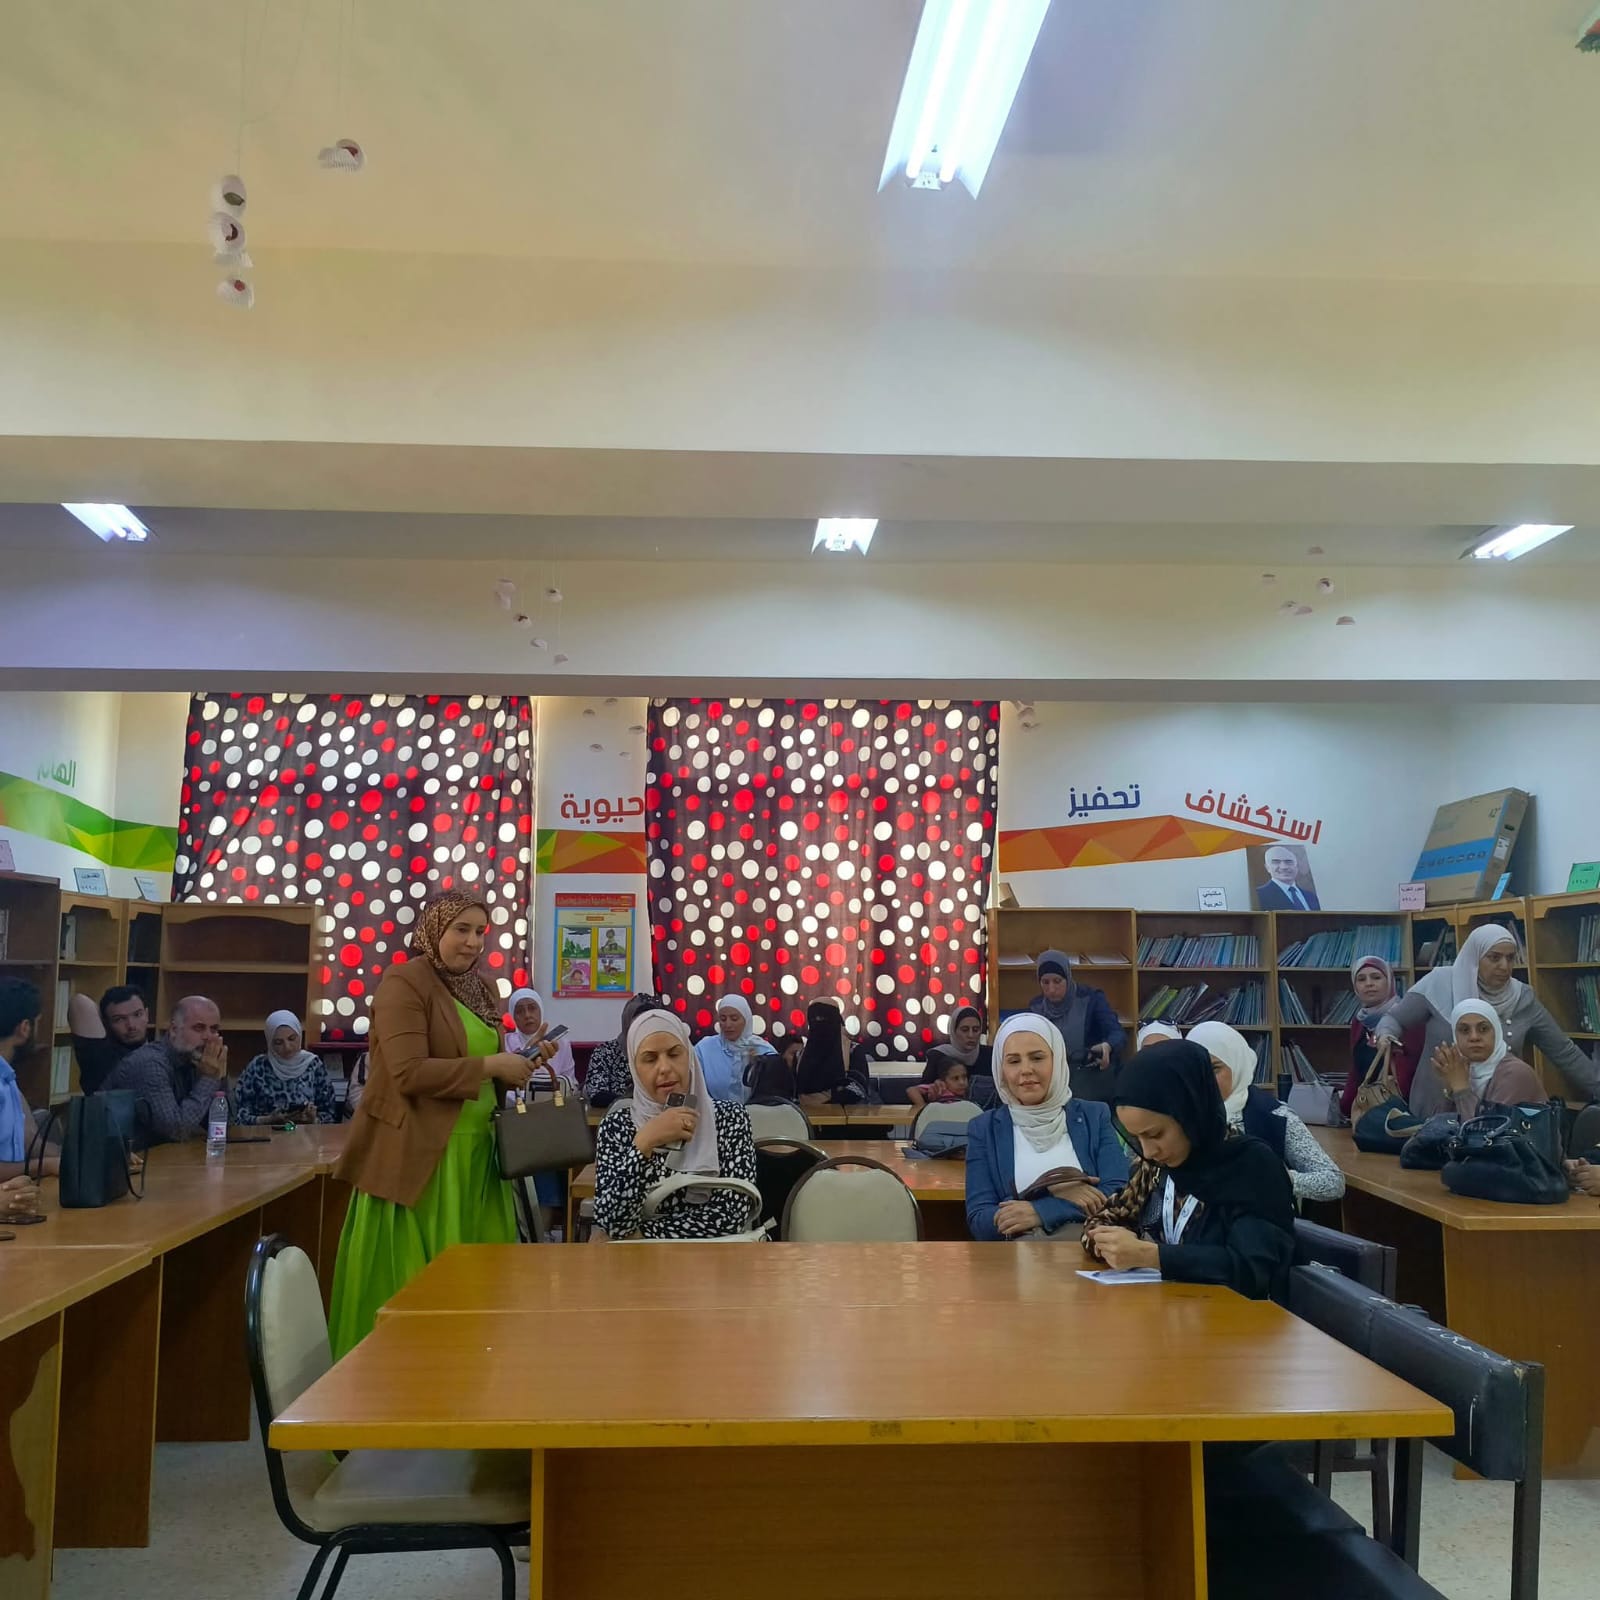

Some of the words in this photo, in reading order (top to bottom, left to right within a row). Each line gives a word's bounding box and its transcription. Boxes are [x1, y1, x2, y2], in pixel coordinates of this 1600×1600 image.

[561, 793, 644, 824] حيوية
[1068, 784, 1141, 818] تحفيز
[1185, 789, 1322, 844] استكشاف
